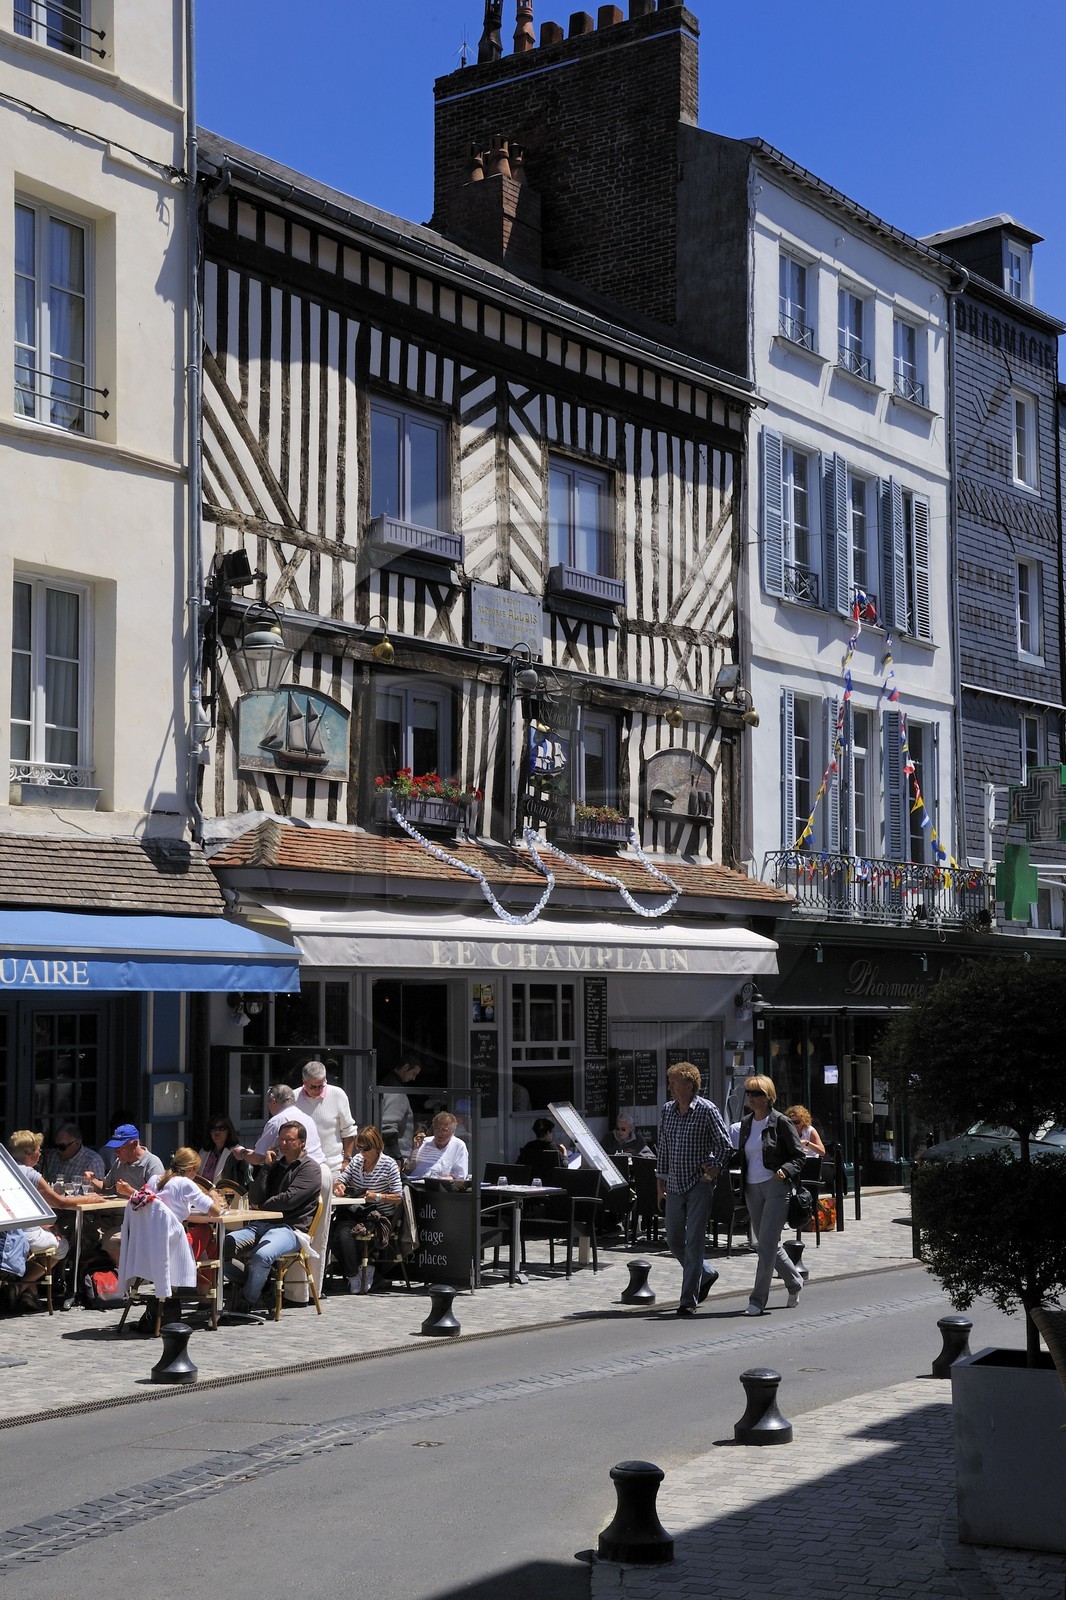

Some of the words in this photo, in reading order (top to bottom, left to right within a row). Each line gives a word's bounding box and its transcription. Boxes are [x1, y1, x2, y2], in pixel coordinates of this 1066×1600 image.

[508, 609, 538, 625] ALLAIS
[431, 941, 476, 966] LE
[491, 942, 689, 971] CHAMPLAIN
[0, 958, 89, 985] UAIRE
[844, 958, 925, 998] Pharmacie
[418, 1249, 448, 1268] places
